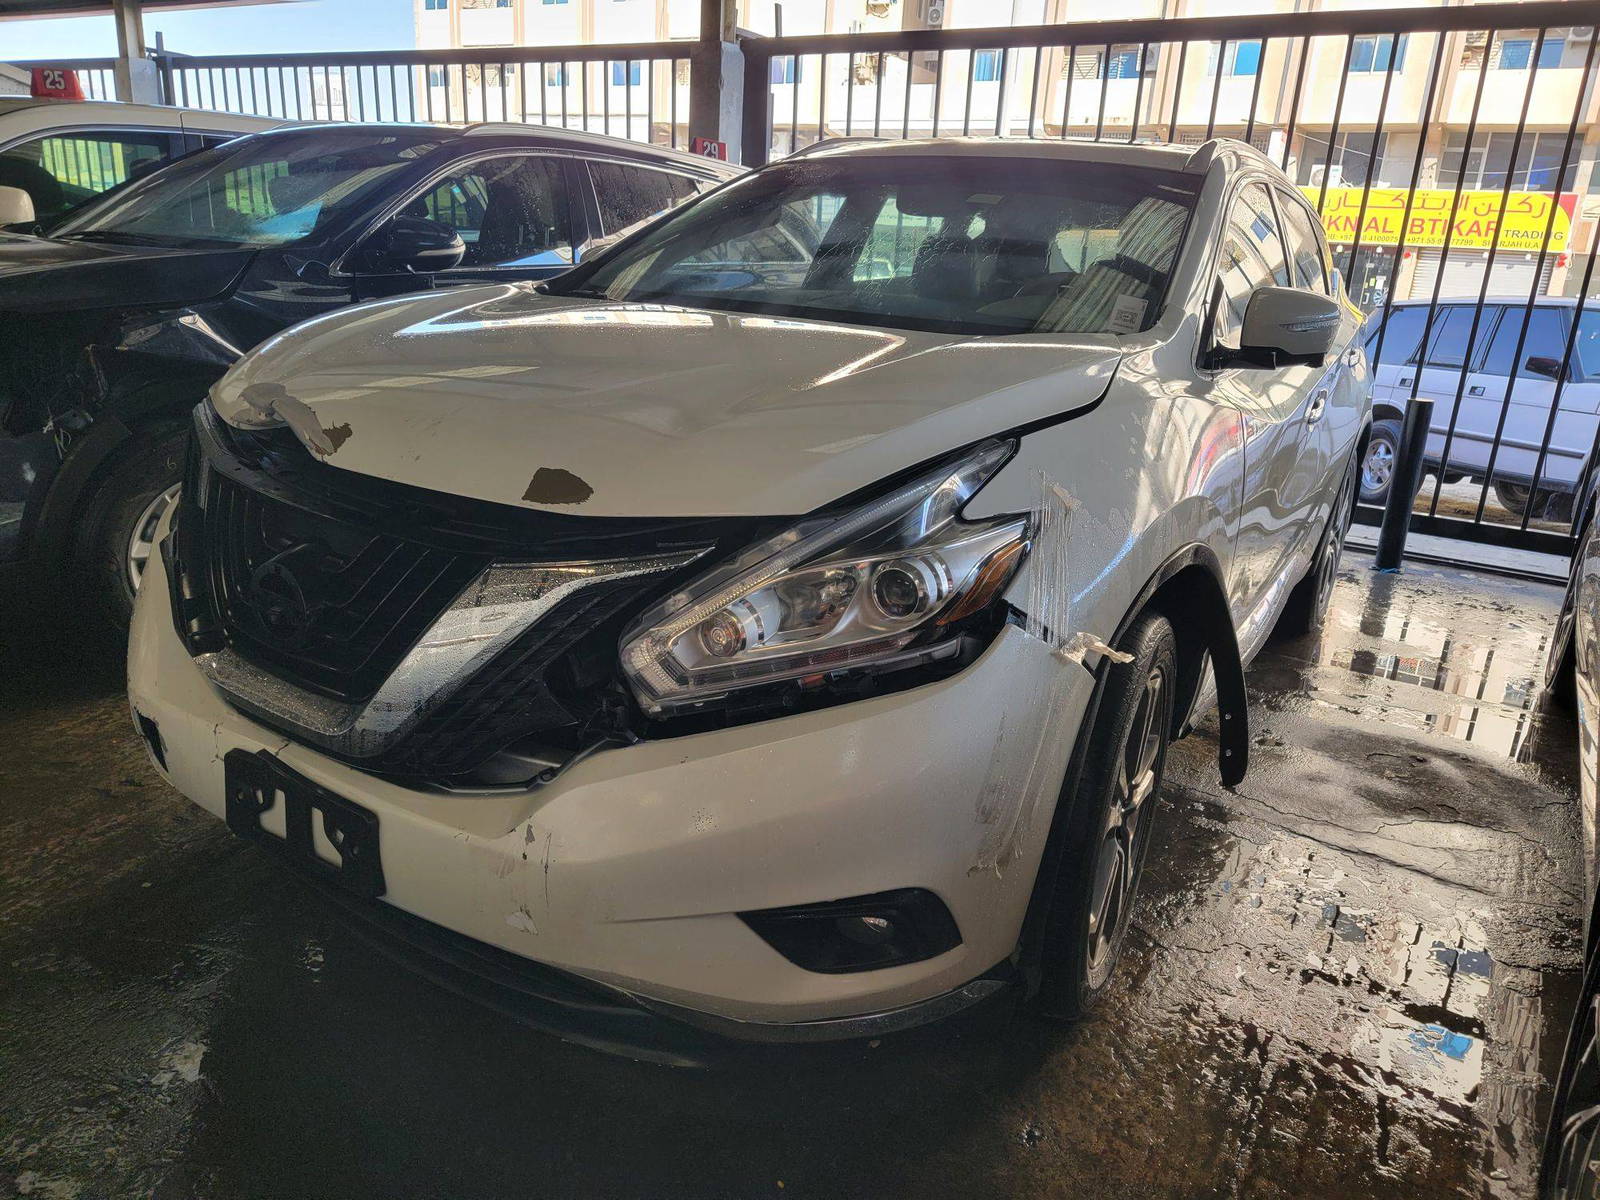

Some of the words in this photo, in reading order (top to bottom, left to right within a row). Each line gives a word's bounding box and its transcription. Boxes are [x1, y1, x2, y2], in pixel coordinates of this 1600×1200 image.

[43, 70, 65, 89] 25
[703, 141, 719, 160] 29
[1474, 195, 1546, 218] ركن
[1364, 216, 1394, 233] AL
[1504, 229, 1564, 241] TRADIG
